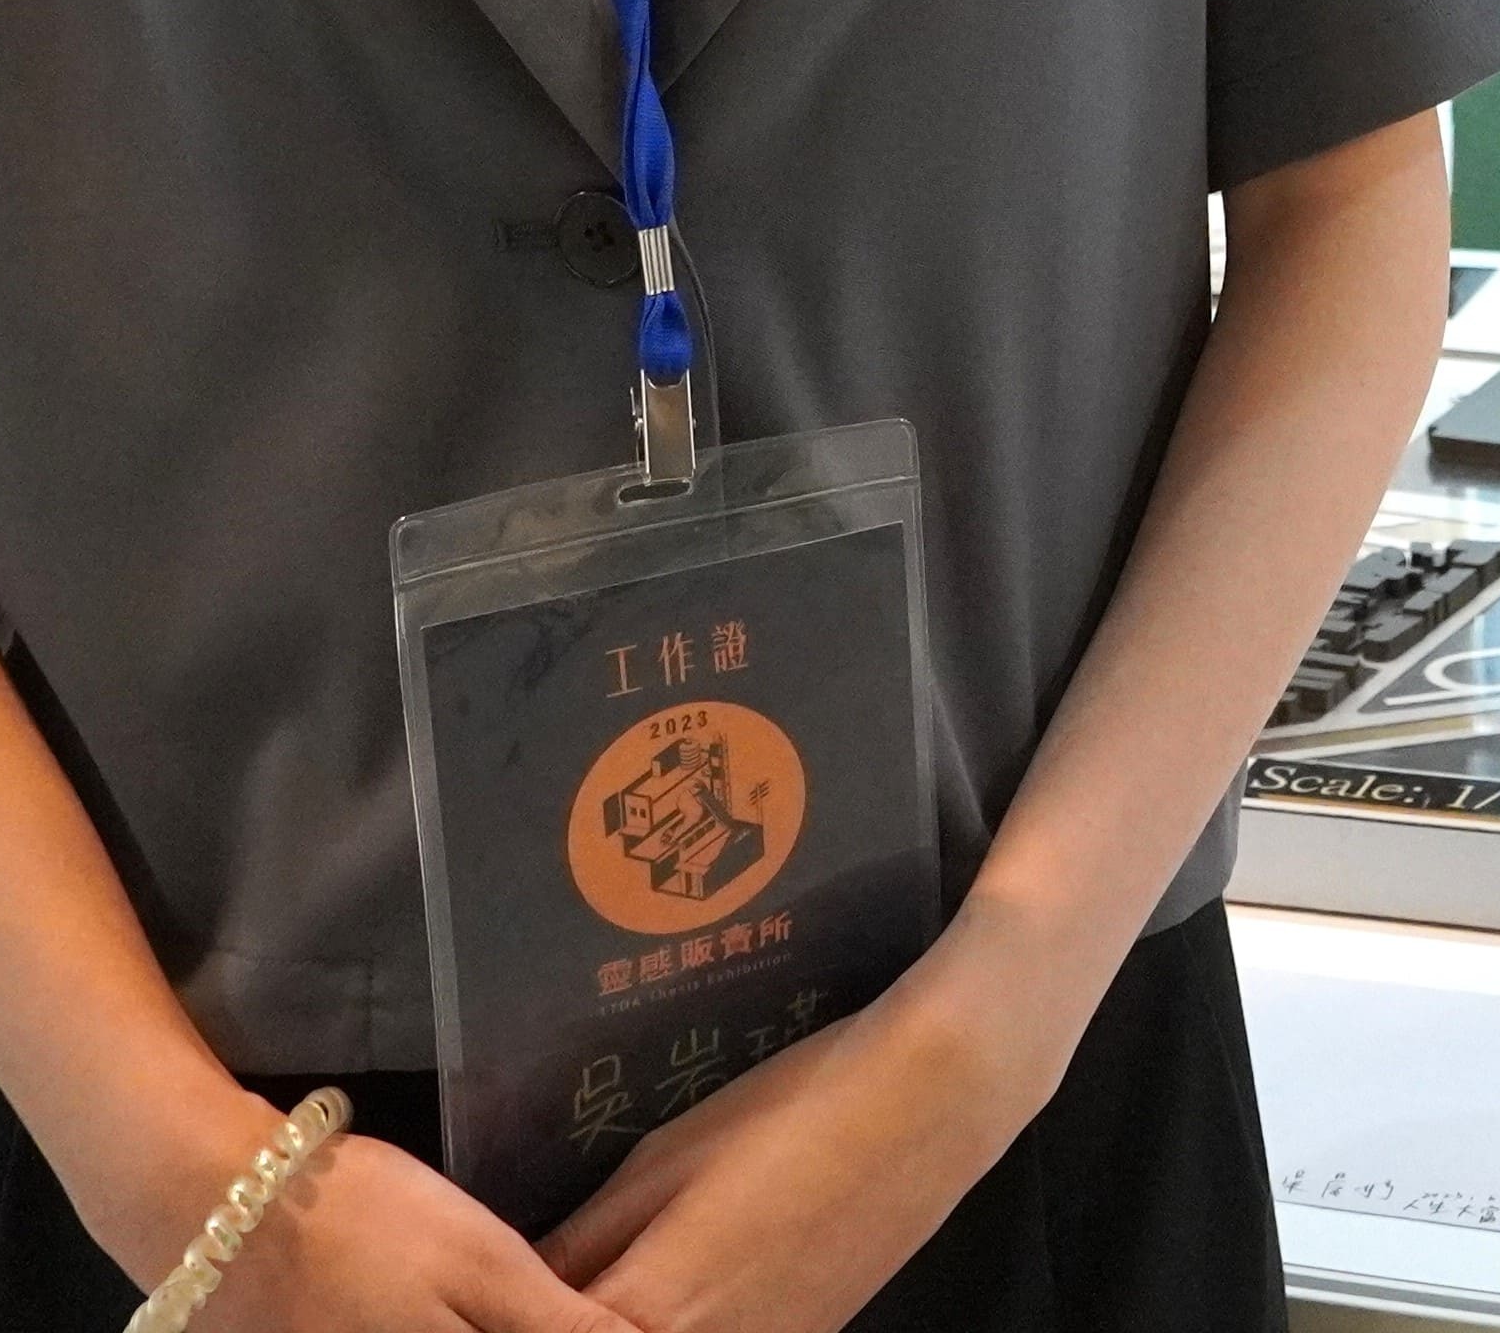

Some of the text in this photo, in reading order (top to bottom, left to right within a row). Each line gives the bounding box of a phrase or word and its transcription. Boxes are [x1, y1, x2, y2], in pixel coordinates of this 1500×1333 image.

[605, 619, 749, 699] 工作證
[649, 710, 709, 740] 2023
[1252, 765, 1421, 805] Scale:
[597, 910, 794, 995] 靈感販賣所
